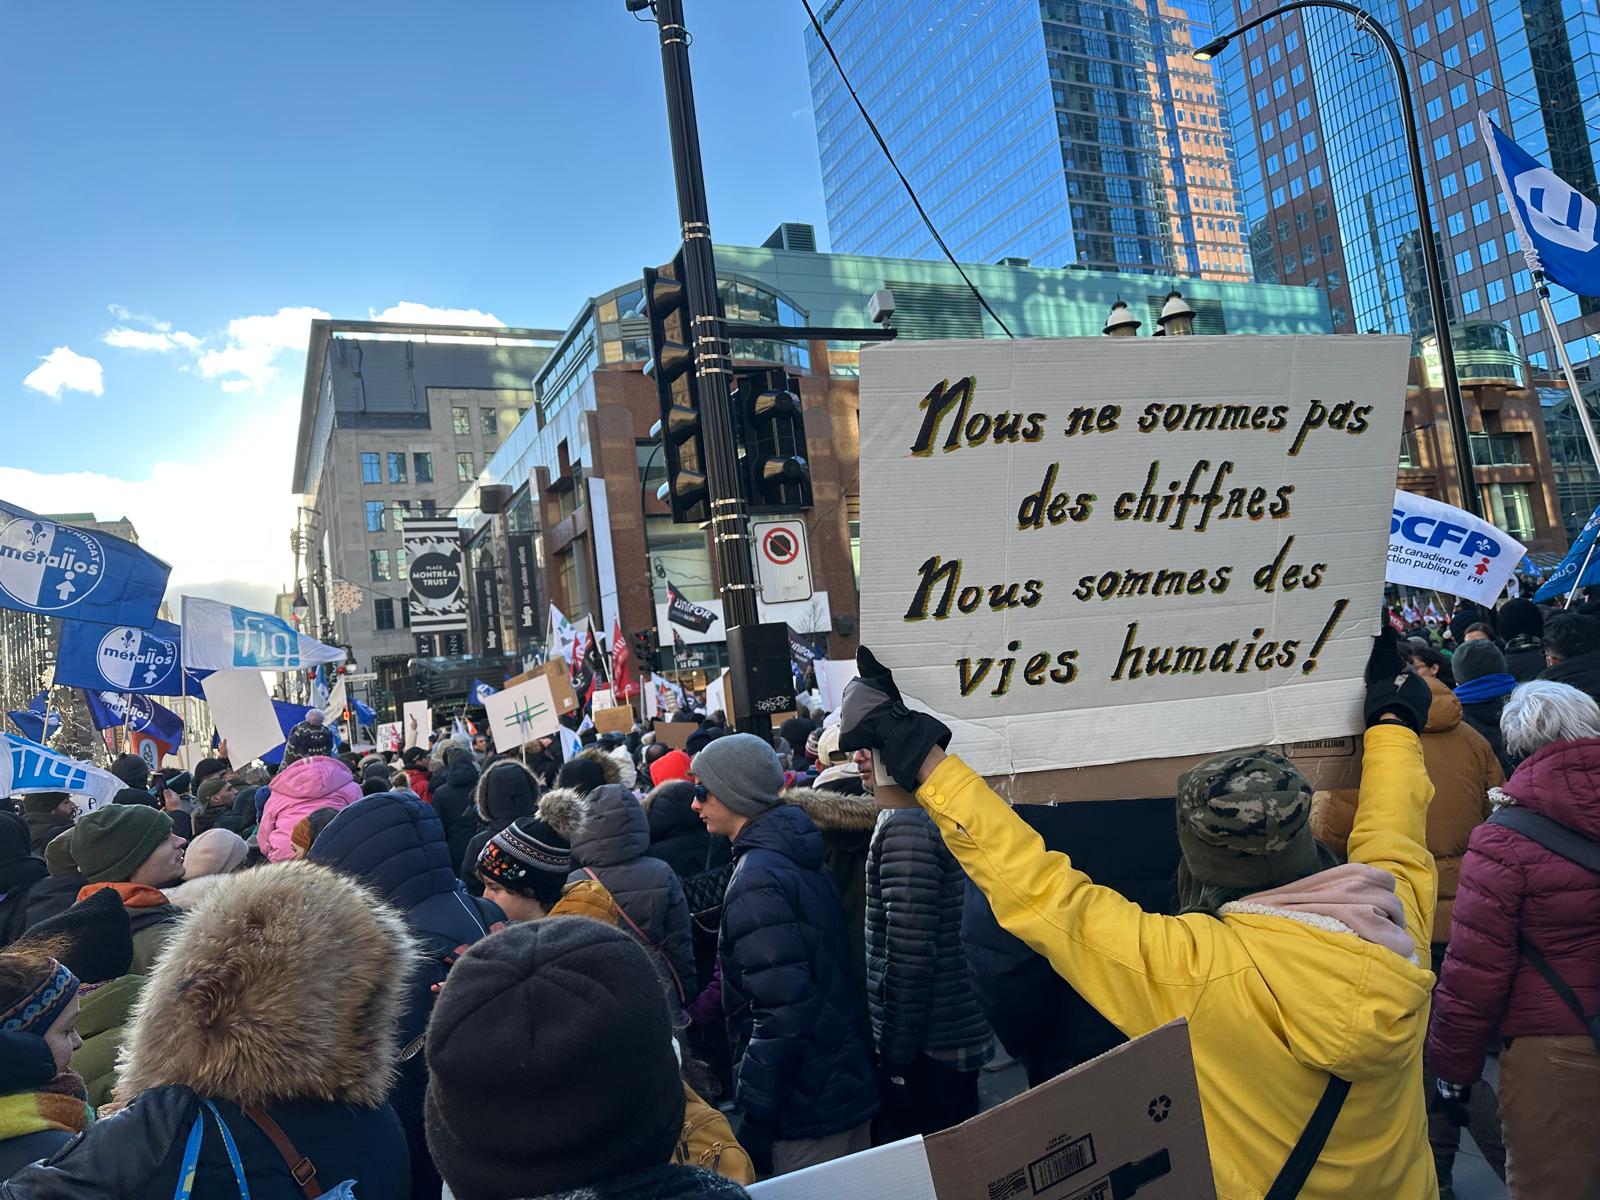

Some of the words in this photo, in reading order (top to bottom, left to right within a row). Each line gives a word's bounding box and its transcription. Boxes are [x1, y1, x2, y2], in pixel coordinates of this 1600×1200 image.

[904, 375, 1047, 457] Nous
[1064, 402, 1121, 434] ne
[1137, 400, 1290, 433] sommes
[1287, 399, 1374, 456] pas
[1016, 461, 1097, 531] des
[1113, 459, 1295, 532] chiffres
[1390, 508, 1501, 558] SCFP
[0, 544, 98, 576] métallos
[412, 569, 458, 579] MONTRÉAL
[1386, 553, 1411, 565] ction
[1413, 558, 1460, 577] publique
[1405, 547, 1452, 565] canadien
[1453, 559, 1468, 570] de
[422, 578, 448, 586] TRUST
[903, 554, 1044, 622] Nous
[1072, 562, 1233, 602] sommes
[1253, 533, 1328, 594] des
[103, 647, 173, 665] métallos
[955, 639, 1079, 697] vies
[1110, 597, 1350, 682] humaies!
